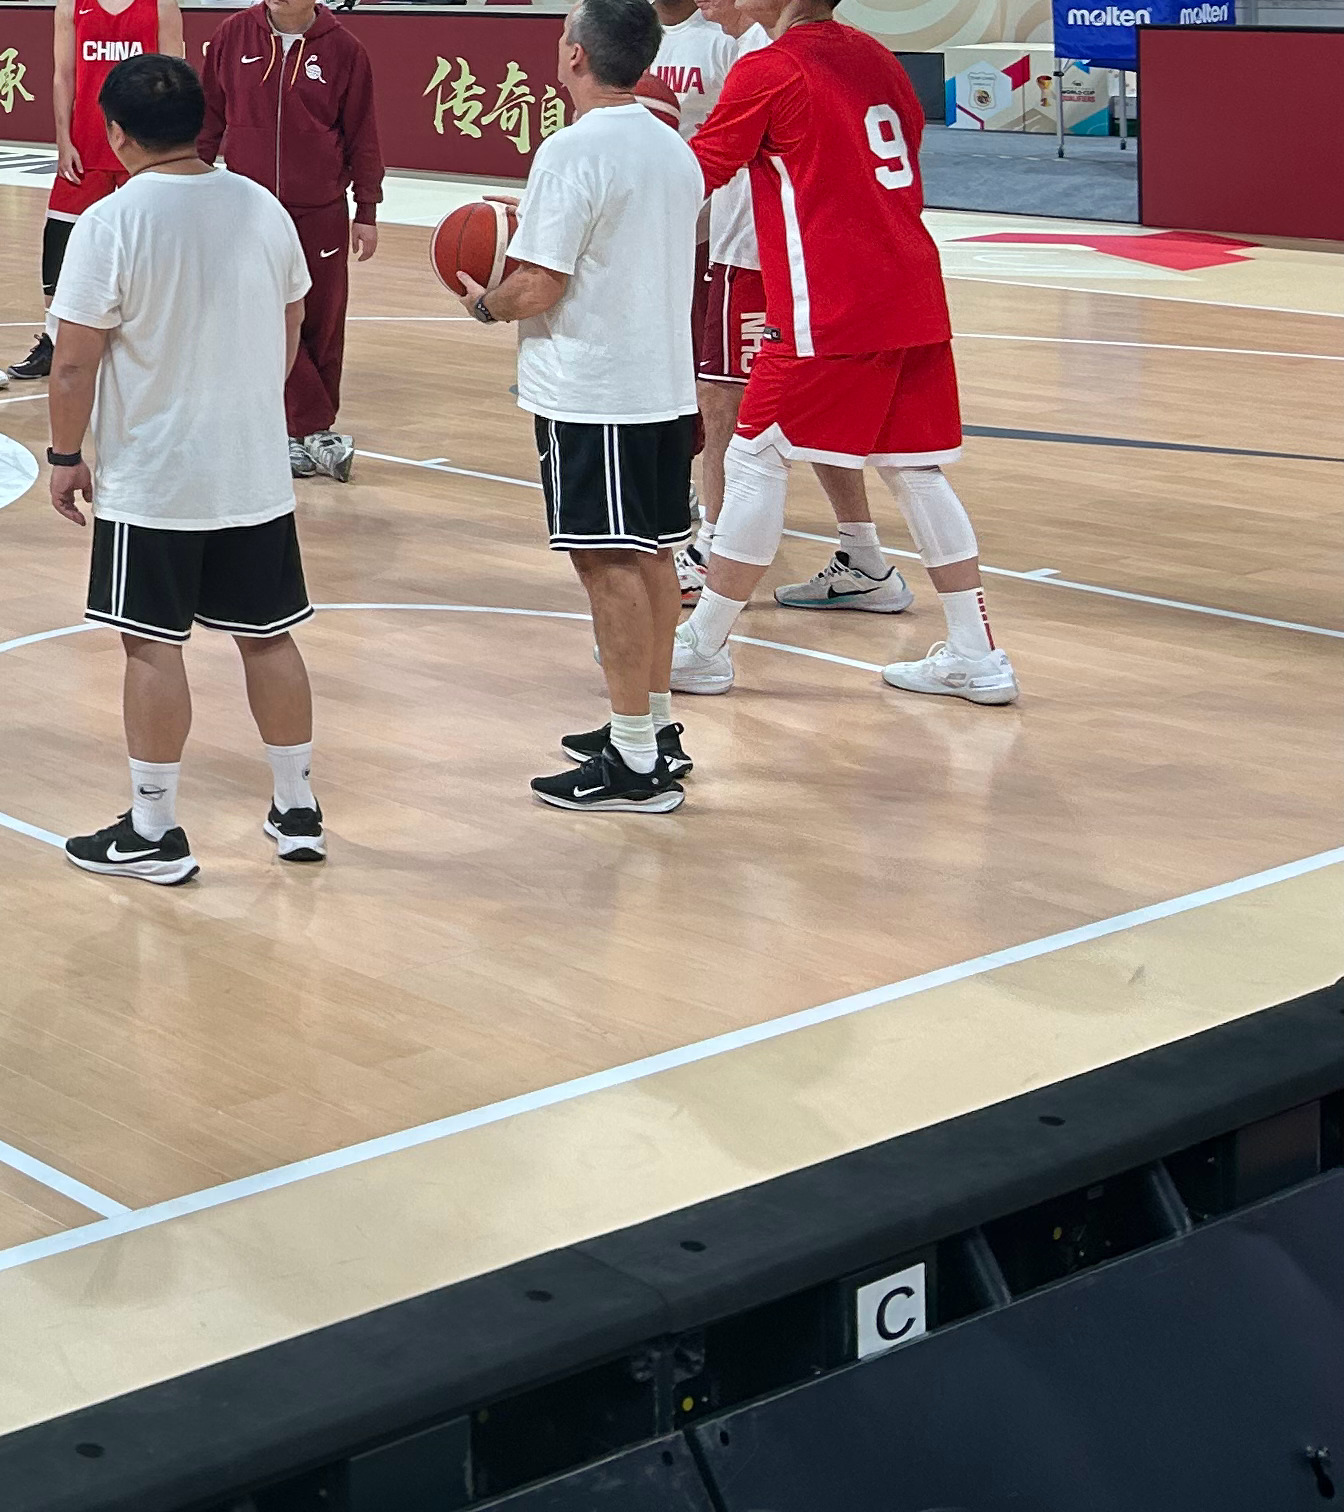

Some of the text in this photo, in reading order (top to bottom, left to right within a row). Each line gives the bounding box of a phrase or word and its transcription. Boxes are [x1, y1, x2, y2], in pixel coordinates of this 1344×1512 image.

[1067, 3, 1228, 26] molten molten
[83, 41, 143, 61] CHINA
[423, 56, 566, 154] 传奇自
[864, 104, 913, 190] 9
[875, 1284, 917, 1341] C
